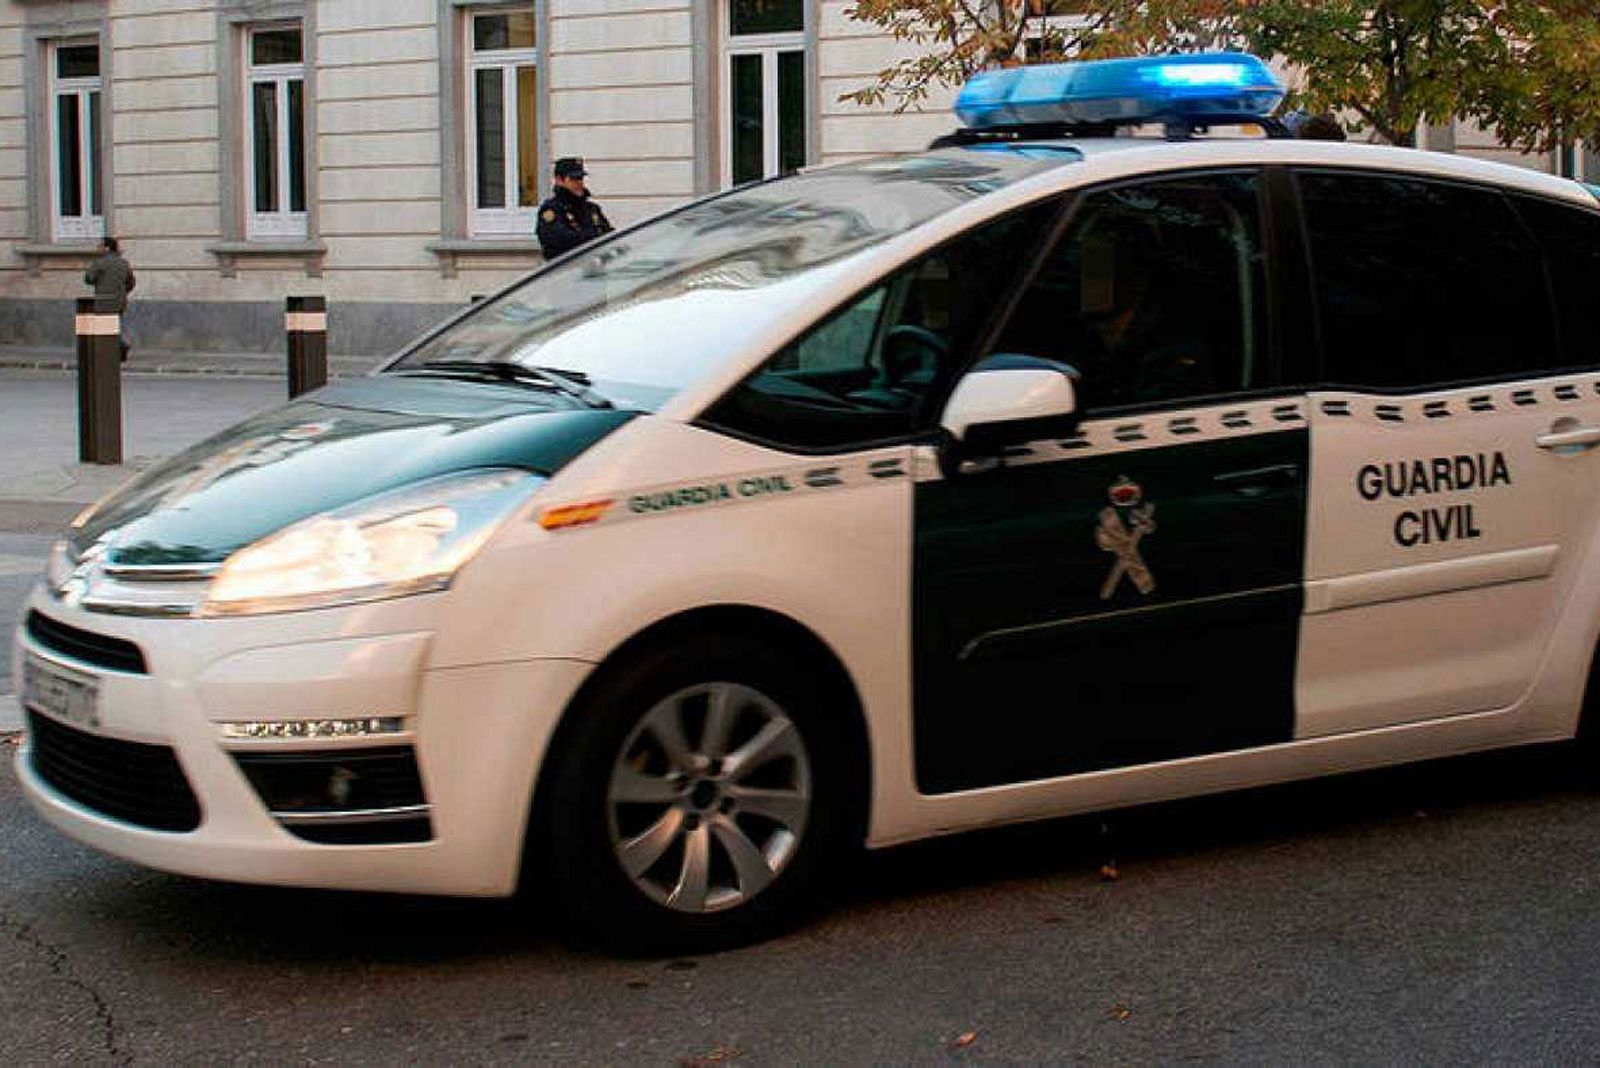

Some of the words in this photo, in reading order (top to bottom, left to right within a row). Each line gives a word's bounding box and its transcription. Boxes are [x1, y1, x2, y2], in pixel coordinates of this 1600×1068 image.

[629, 482, 730, 513] GUARDIA
[736, 476, 793, 497] CIVIL
[1356, 452, 1511, 500] GUARDIA
[1394, 504, 1480, 546] CIVIL
